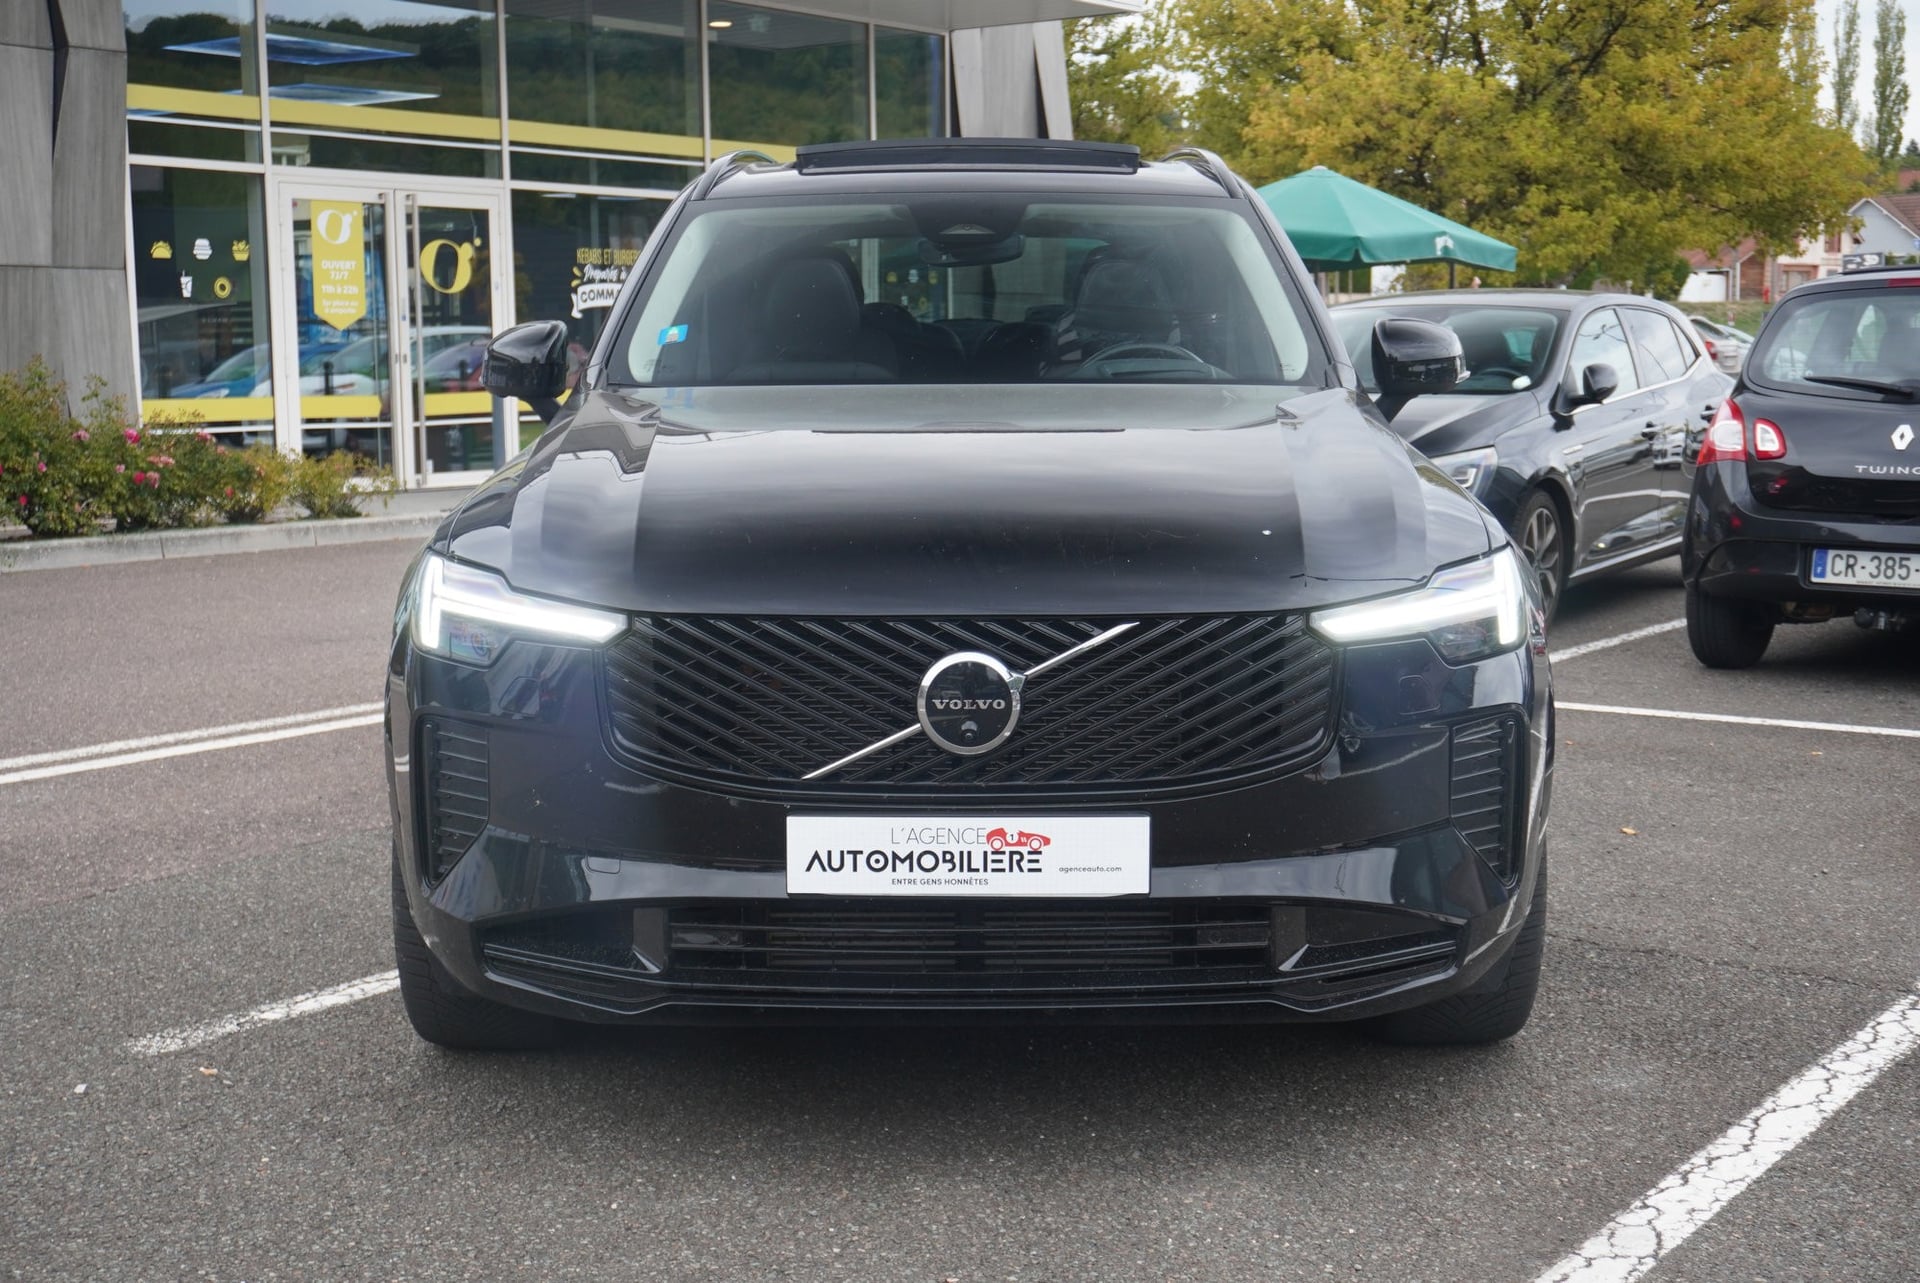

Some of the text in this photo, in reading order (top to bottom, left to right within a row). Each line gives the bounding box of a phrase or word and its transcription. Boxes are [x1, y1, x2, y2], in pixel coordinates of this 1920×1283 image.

[577, 248, 602, 264] KEBABS
[604, 249, 611, 264] ET
[322, 260, 356, 270] OUVERT
[581, 289, 621, 303] COMM
[932, 699, 1006, 710] VOLVO
[891, 827, 987, 845] L'AGENCE
[1059, 866, 1122, 874] agenceauto.com
[891, 876, 989, 886] ENTRE GENS HONNÊTES
